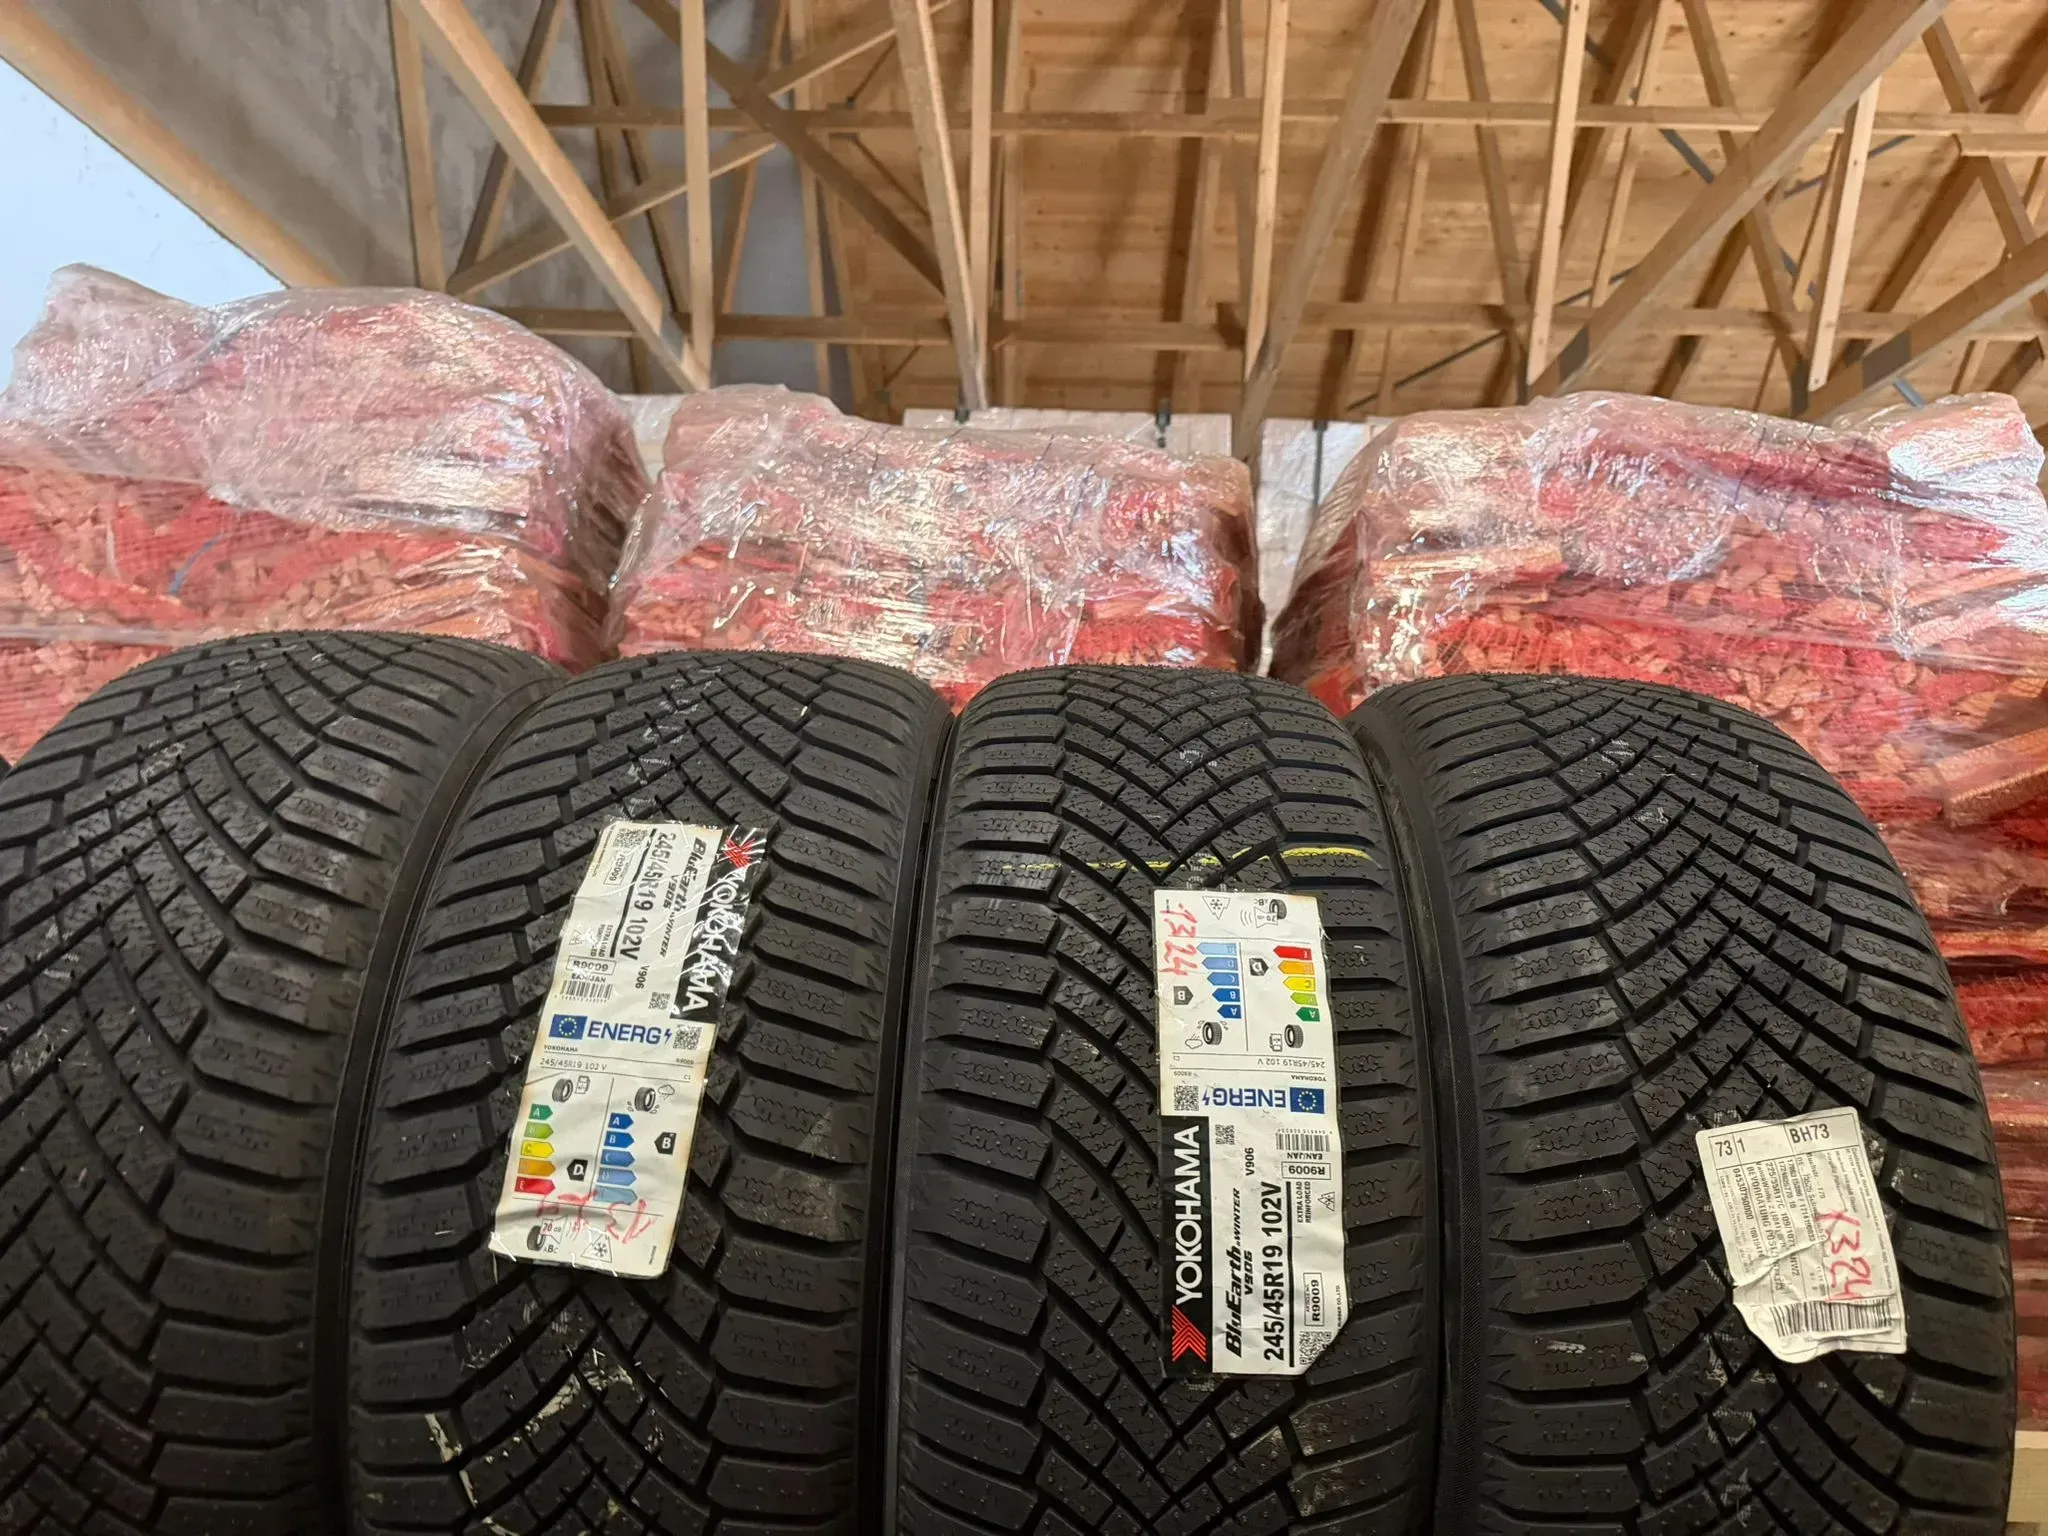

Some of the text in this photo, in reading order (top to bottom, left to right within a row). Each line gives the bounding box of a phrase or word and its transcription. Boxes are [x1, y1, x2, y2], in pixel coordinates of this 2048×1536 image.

[620, 832, 677, 960] 245/45R19 102V
[635, 965, 650, 989] V906
[587, 1020, 663, 1044] ENERG
[540, 1058, 583, 1070] 245/45R19
[585, 1062, 600, 1070] 102
[1265, 1058, 1281, 1066] 102
[1283, 1057, 1326, 1068] 245/45R19
[1290, 1074, 1327, 1082] YOKOHAMA
[1213, 1087, 1286, 1108] ENERG
[1737, 1137, 1746, 1154] 1
[1789, 1123, 1830, 1145] BH73
[1286, 1152, 1323, 1161] EAN/JAN
[1715, 1139, 1734, 1157] 73
[1245, 1147, 1255, 1176] V906
[1288, 1165, 1325, 1176] R9009
[1295, 1181, 1304, 1223] EXTRA LOAD
[1304, 1181, 1312, 1223] REINFORCED
[1174, 1125, 1203, 1305] YOKOHAMA
[1816, 1209, 1871, 1303] 1324
[1244, 1250, 1253, 1295] V906
[1260, 1182, 1285, 1361] 245/45R19 102V
[1225, 1246, 1242, 1358] BluEarth
[1311, 1279, 1321, 1322] R9009
